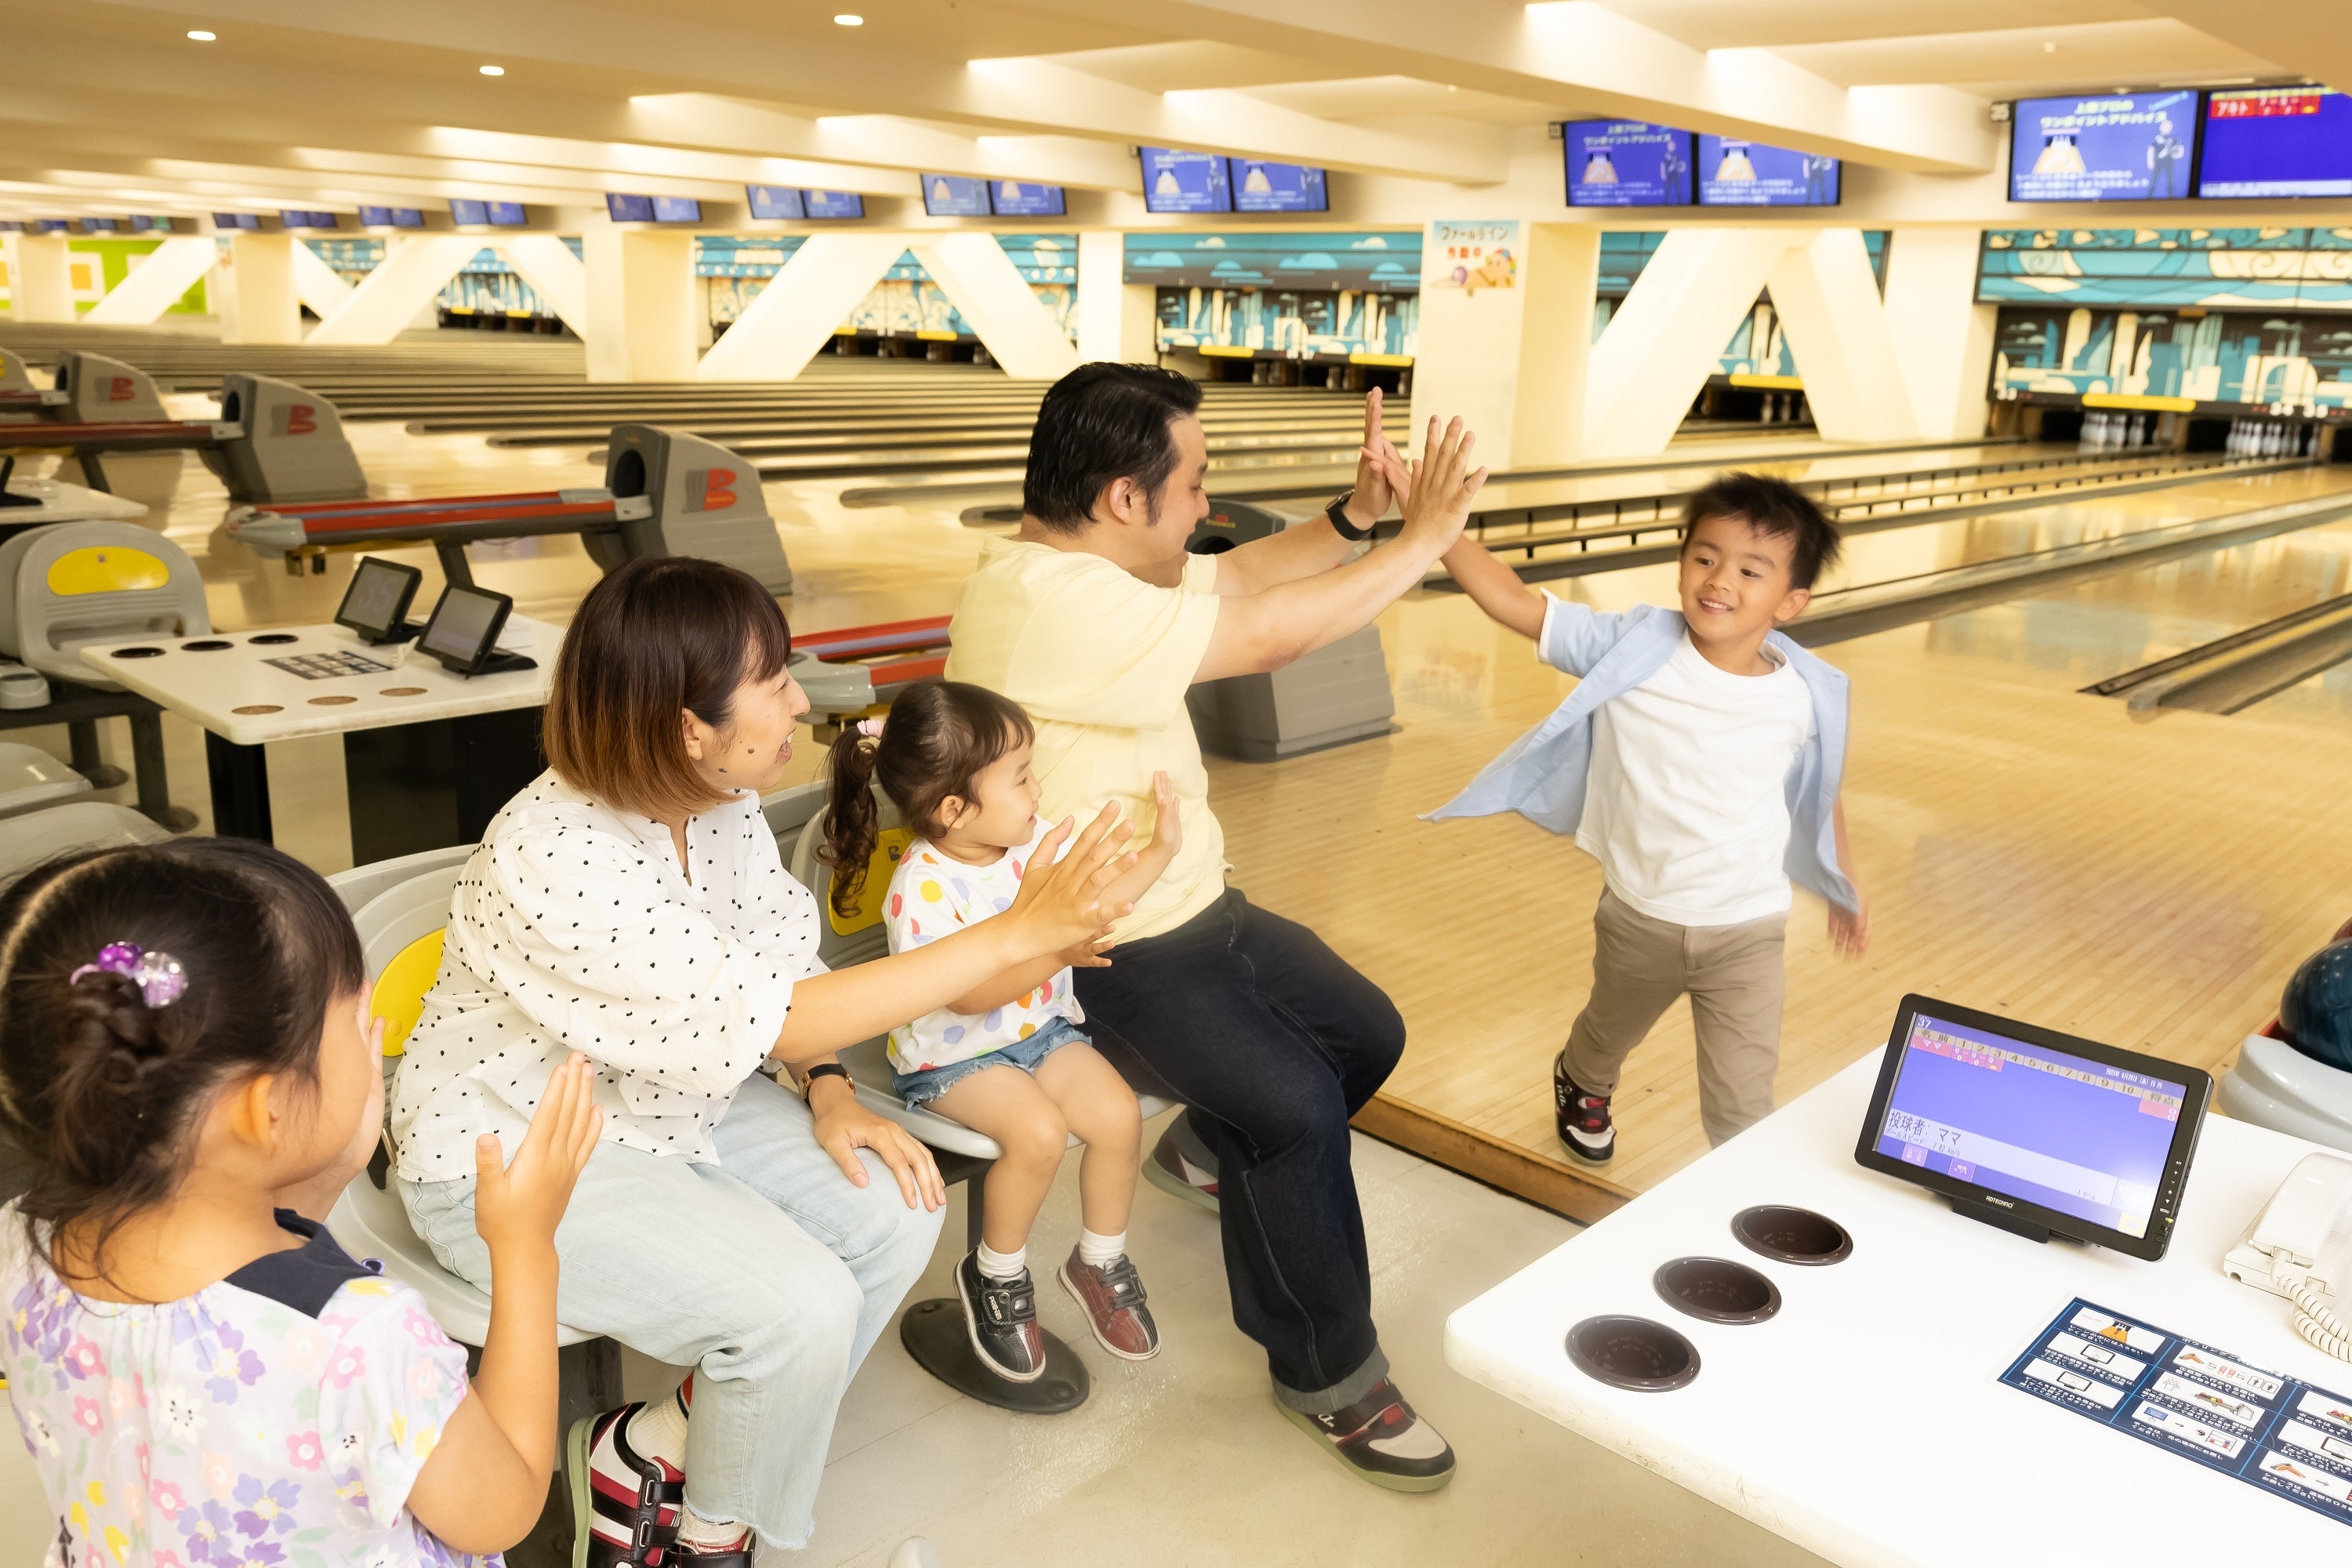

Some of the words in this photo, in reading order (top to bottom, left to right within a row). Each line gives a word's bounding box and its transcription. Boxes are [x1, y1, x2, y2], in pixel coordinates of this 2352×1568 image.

[1918, 1018, 1932, 1029] 37
[1976, 1044, 1984, 1052] 2
[2101, 1079, 2109, 1087] 9
[2122, 1084, 2134, 1094] 10
[1939, 1127, 1962, 1145] ママ
